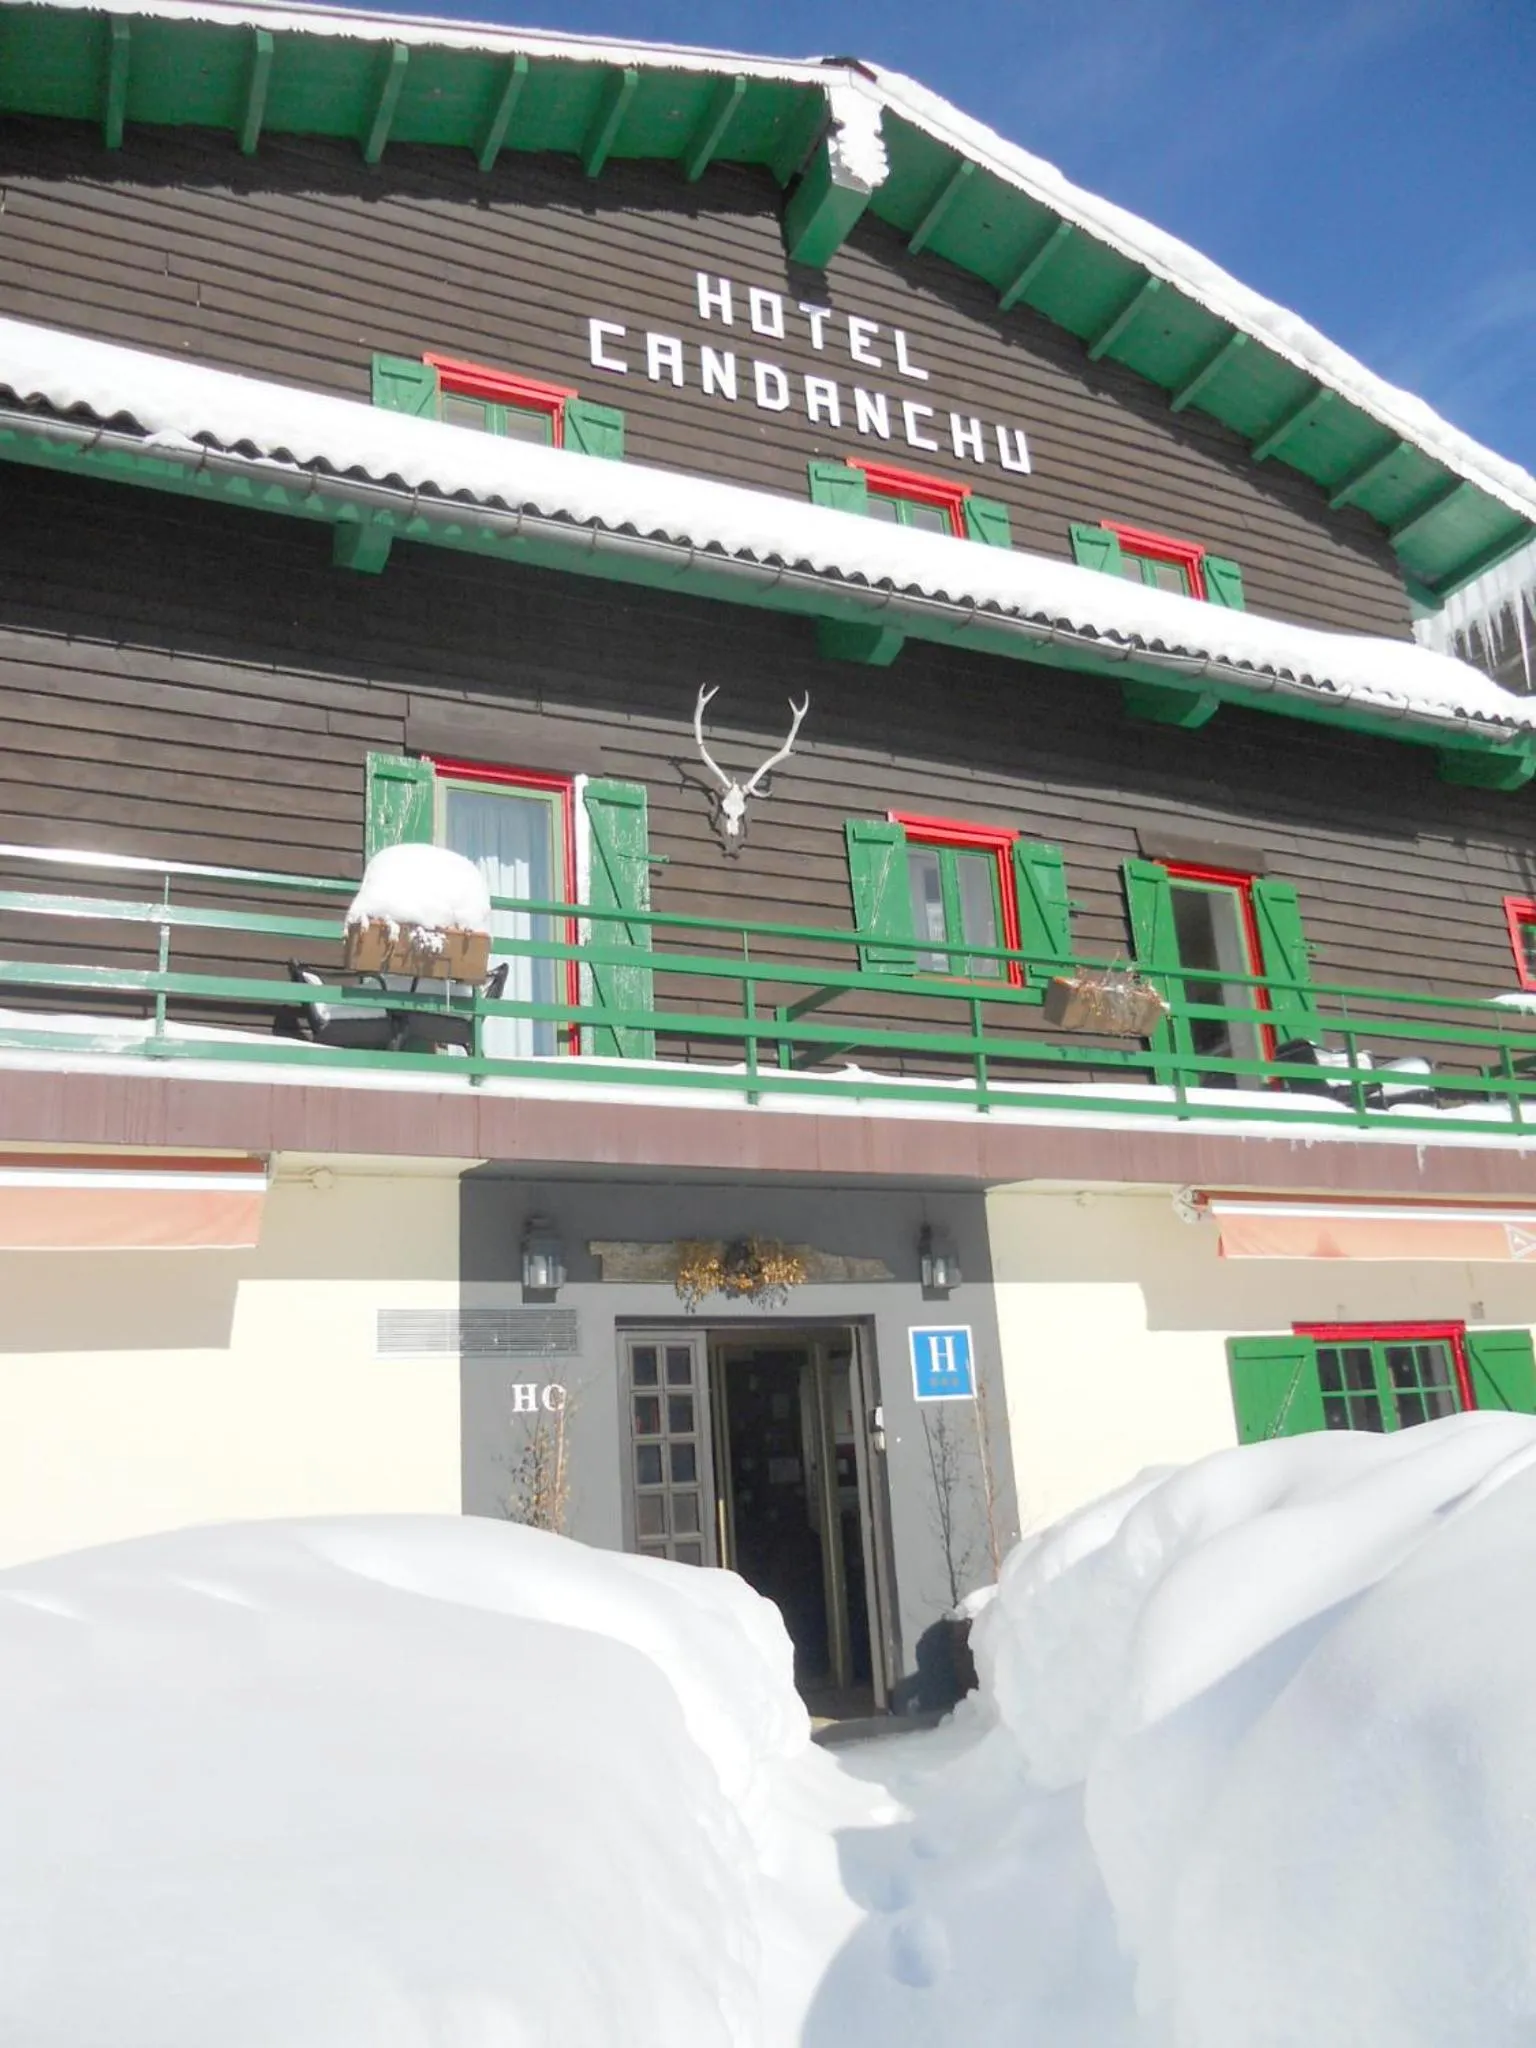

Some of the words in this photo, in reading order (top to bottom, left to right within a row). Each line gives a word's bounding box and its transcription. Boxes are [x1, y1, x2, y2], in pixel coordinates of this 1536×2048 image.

[696, 272, 929, 380] HOTEL
[589, 318, 1032, 474] CANDANCHU
[928, 1336, 957, 1372] H
